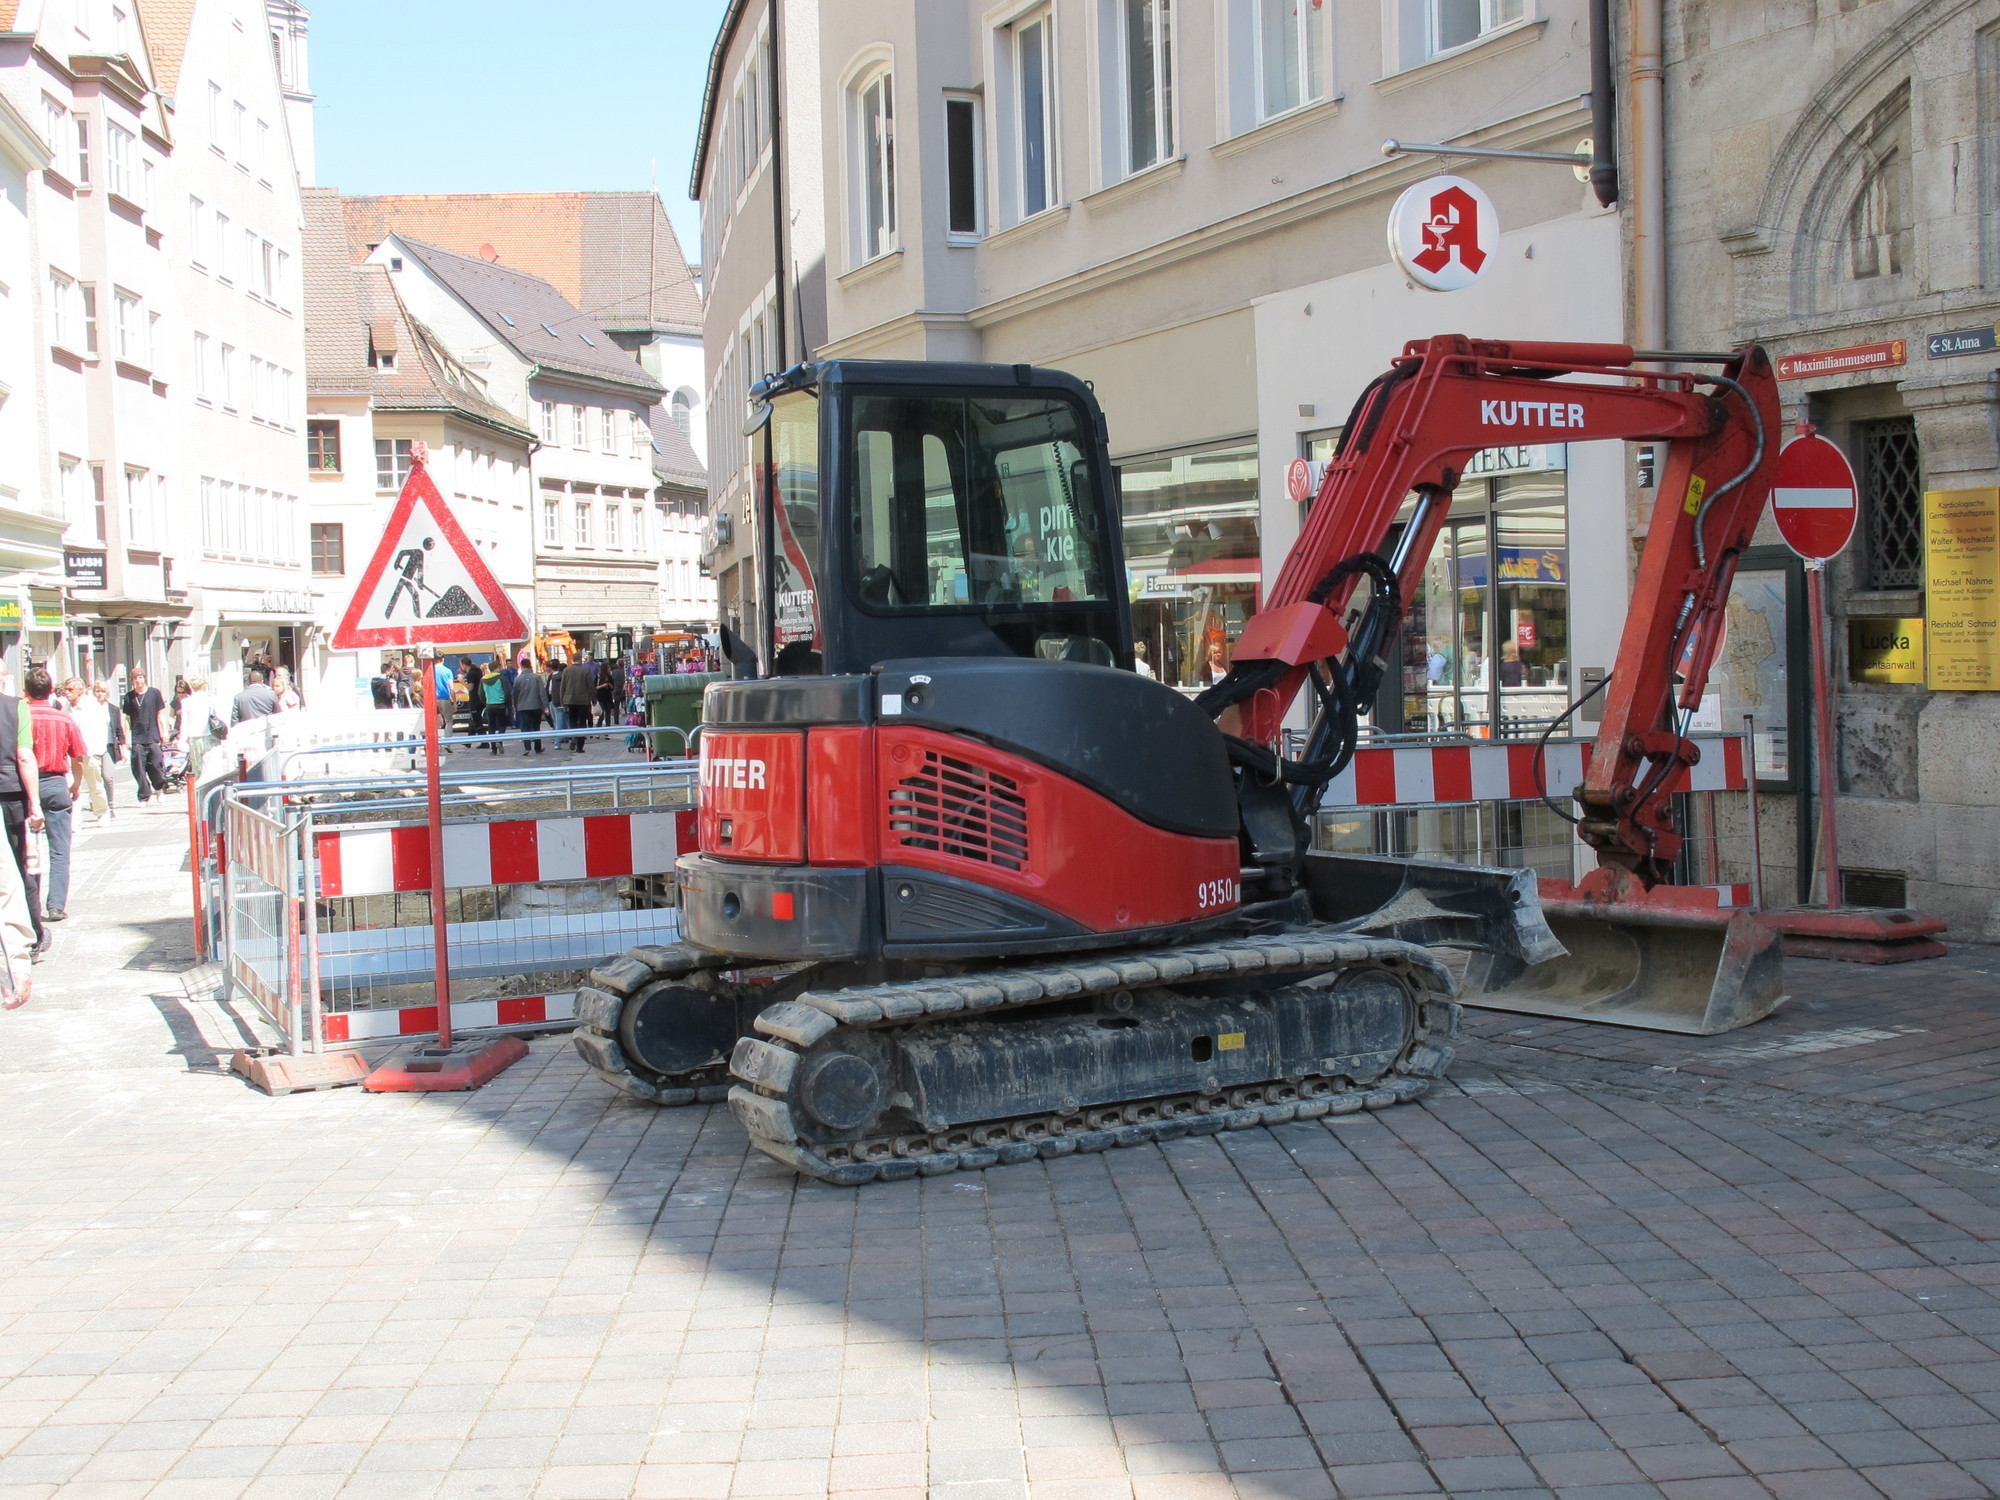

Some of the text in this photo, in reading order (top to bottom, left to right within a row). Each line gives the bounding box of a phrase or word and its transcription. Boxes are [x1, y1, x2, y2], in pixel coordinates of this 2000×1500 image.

[1954, 337, 1981, 350] Anna
[1793, 352, 1886, 373] Maximilianmuseum
[1481, 400, 1584, 428] KUTTER
[1938, 501, 1985, 509] Kardiologische
[1929, 510, 1995, 519] Gemeinschaftspraxis
[1930, 537, 1953, 546] Walter
[69, 557, 103, 567] LUSH
[1932, 578, 1961, 586] Michael
[779, 589, 814, 607] KUTTER
[1931, 620, 1996, 628] Reinhold Schmid
[1861, 632, 1910, 650] Lucka
[1856, 660, 1916, 669] Rechtsanwalt
[1199, 878, 1232, 908] 9350
